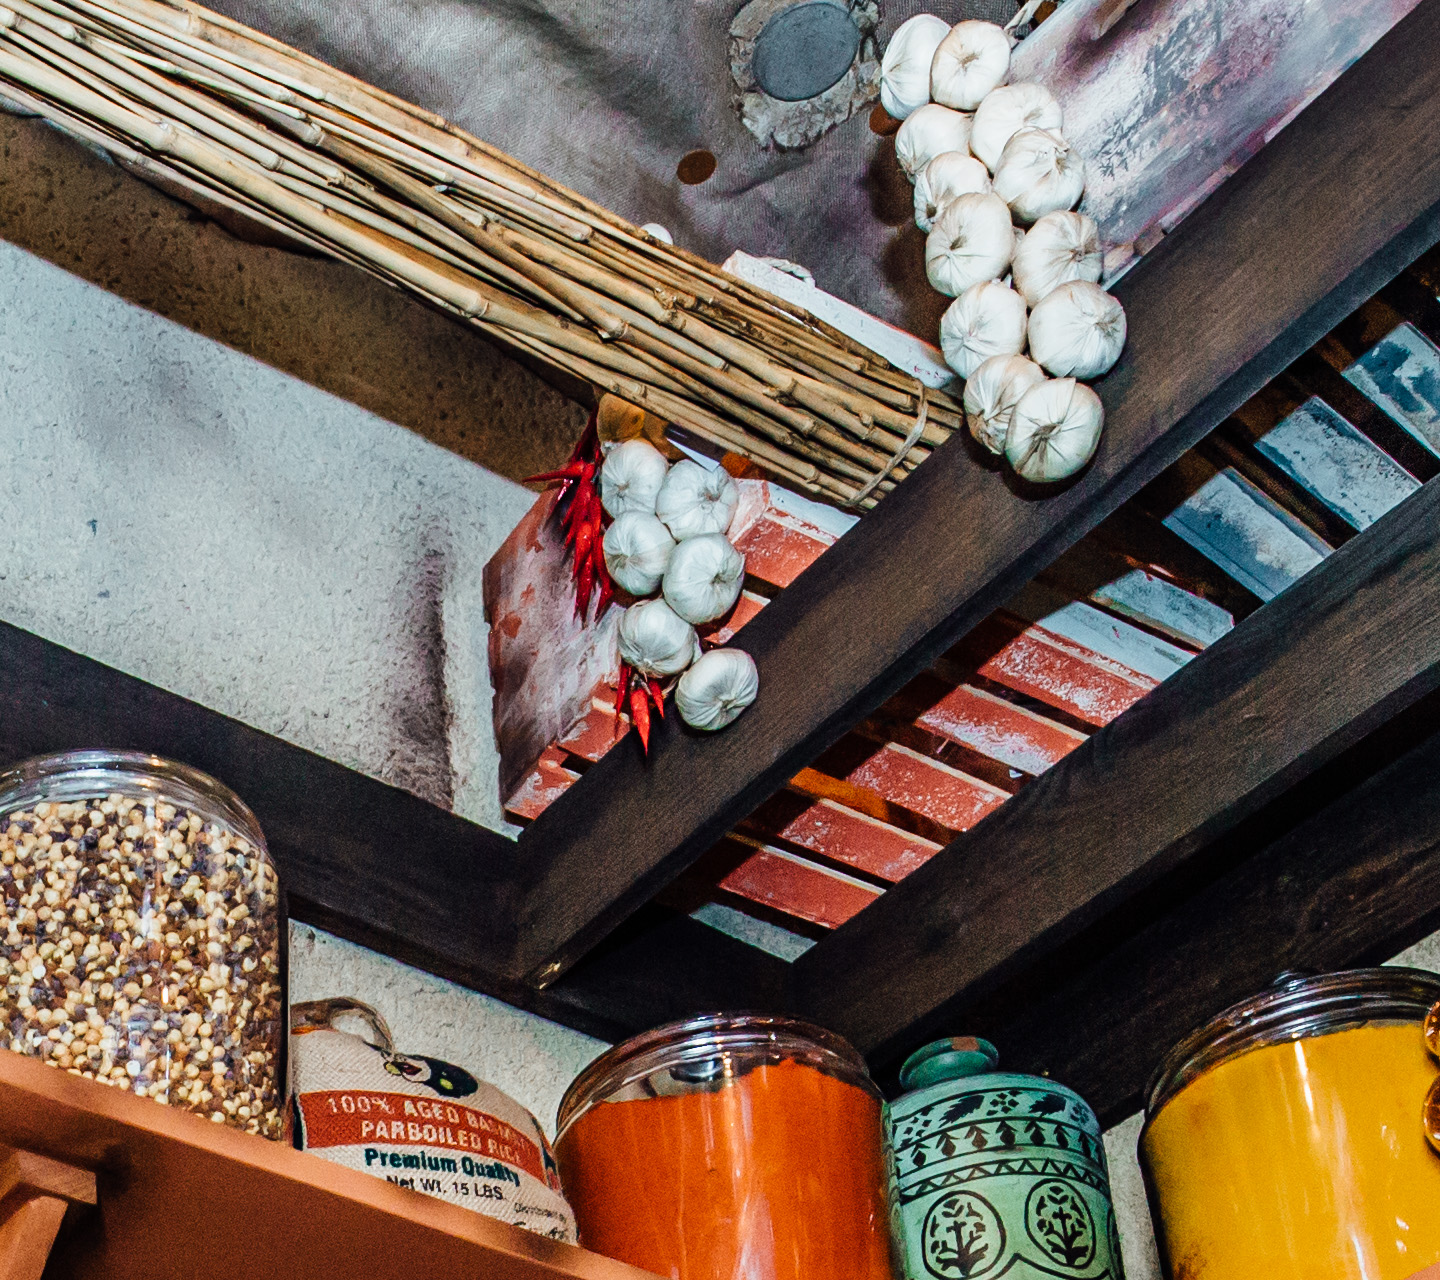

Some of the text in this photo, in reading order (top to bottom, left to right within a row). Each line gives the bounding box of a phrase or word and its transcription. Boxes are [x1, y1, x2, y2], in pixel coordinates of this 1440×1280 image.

[327, 1095, 395, 1115] 100%
[404, 1101, 459, 1124] AGED
[361, 1120, 481, 1149] PARBOILED
[365, 1148, 520, 1188] Premium Quality
[452, 1181, 470, 1196] 15
